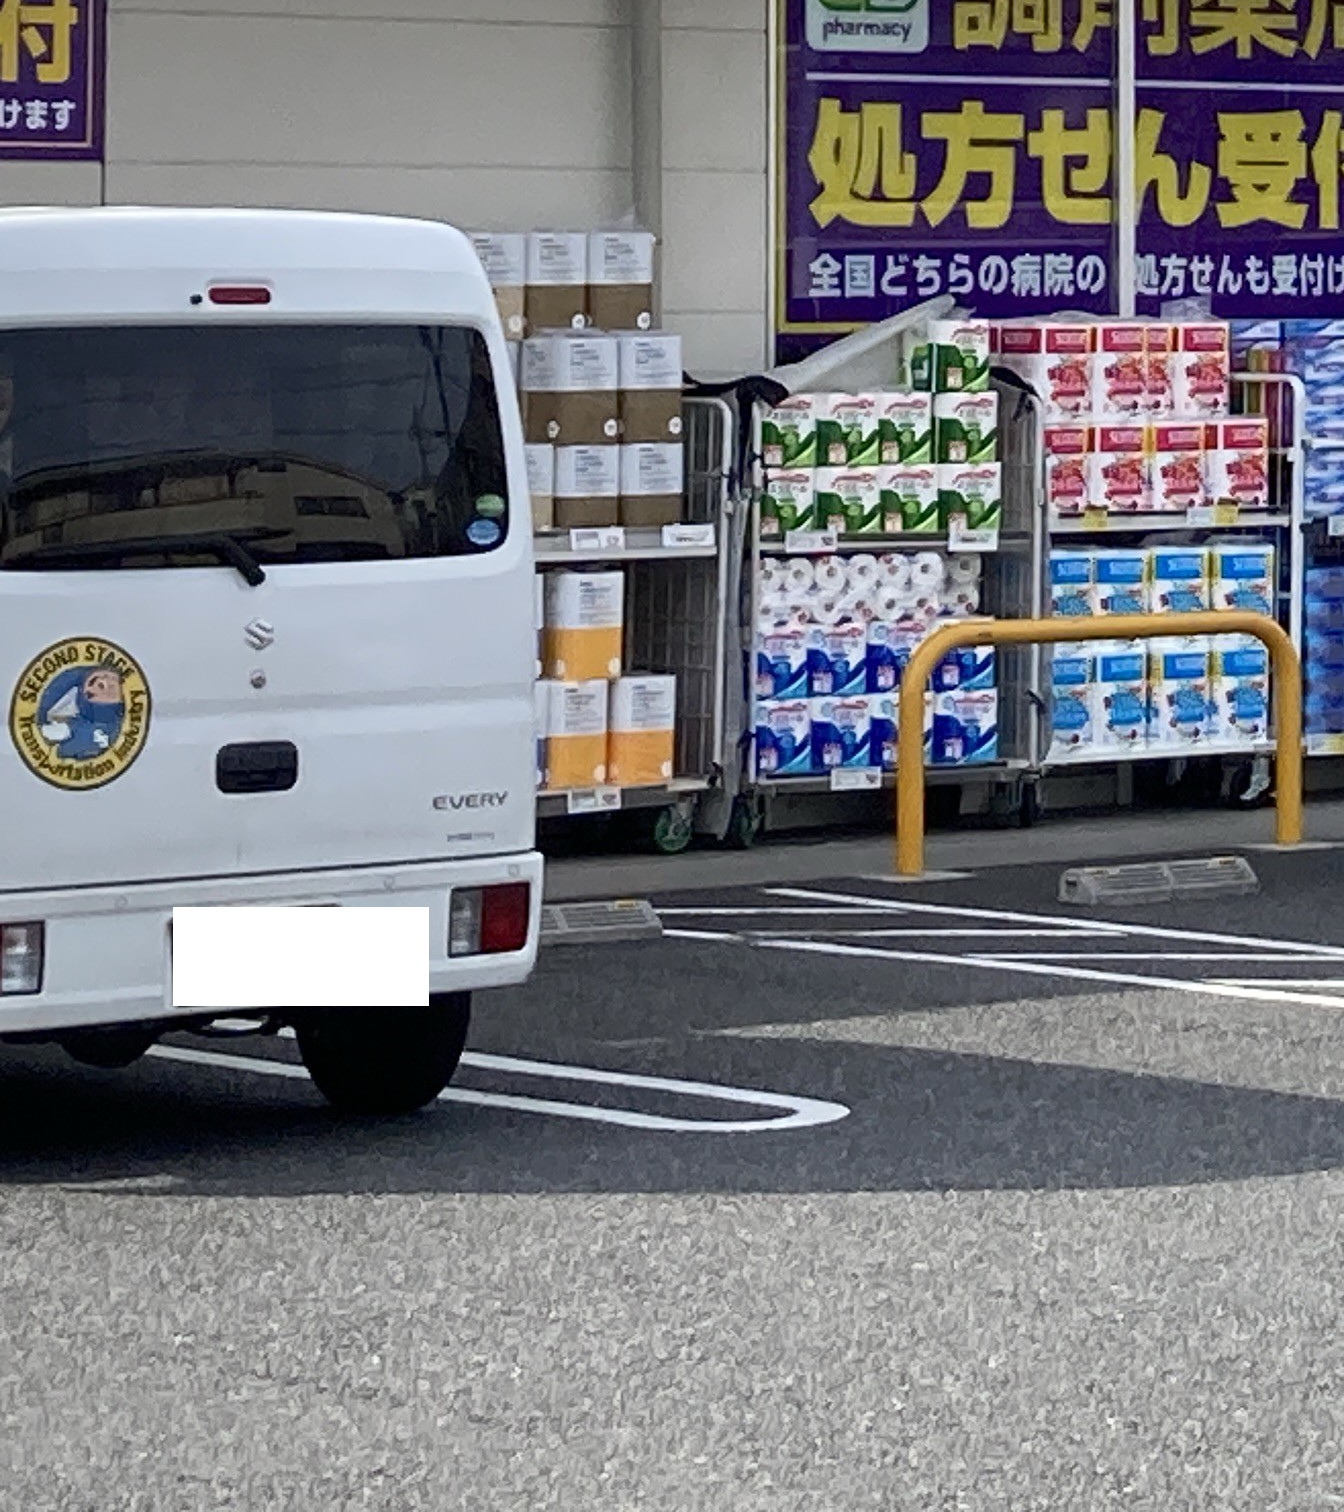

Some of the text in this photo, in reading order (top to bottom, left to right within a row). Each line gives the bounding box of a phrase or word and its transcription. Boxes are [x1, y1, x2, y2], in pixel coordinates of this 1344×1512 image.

[822, 17, 912, 44] pharmacy
[20, 645, 79, 703] SECOND
[18, 713, 116, 782] Transportation
[432, 790, 509, 811] EVERY
